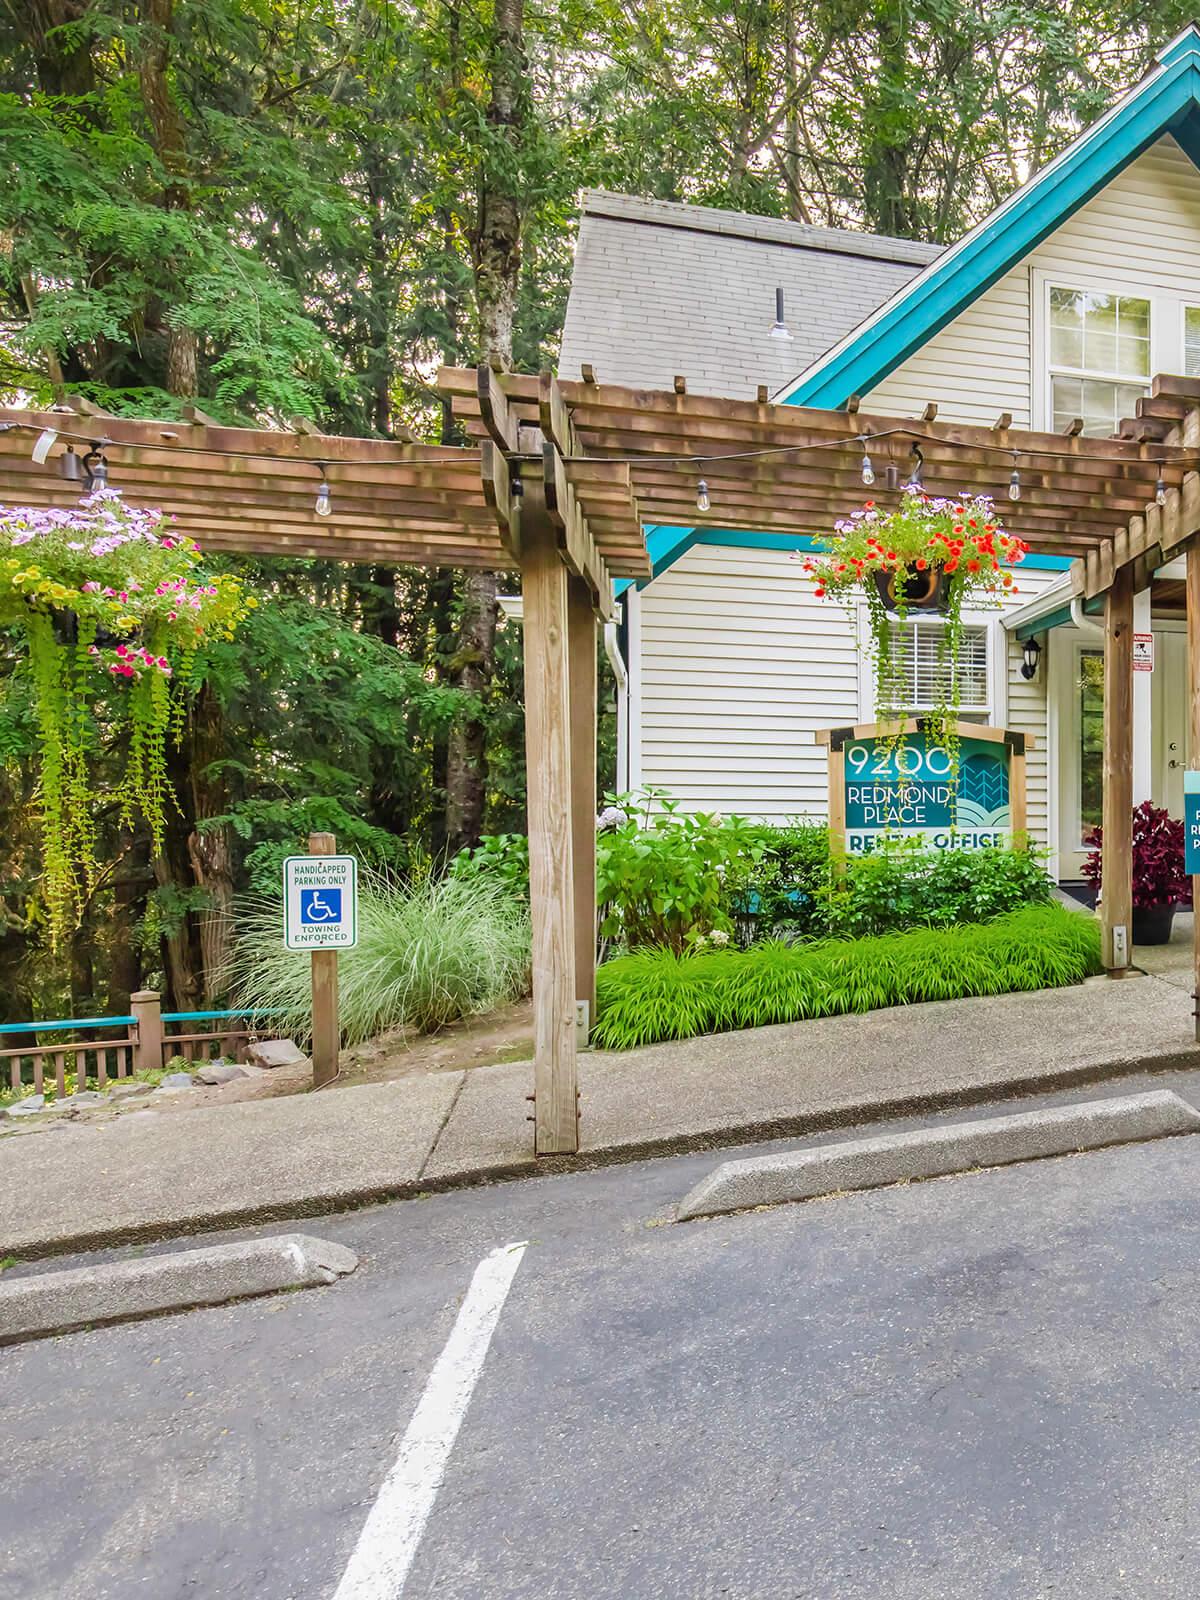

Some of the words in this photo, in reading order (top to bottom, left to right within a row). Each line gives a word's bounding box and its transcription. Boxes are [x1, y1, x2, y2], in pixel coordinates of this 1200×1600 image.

[848, 746, 954, 774] 9200
[848, 786, 951, 804] REDMOND
[864, 806, 927, 824] PLACE
[933, 833, 1006, 849] OFFICE
[294, 865, 347, 875] HANDICAPPED
[294, 876, 327, 886] PARKING
[328, 876, 347, 885] ONLY
[302, 925, 341, 933] TOWING
[294, 933, 348, 942] ENFORCED
